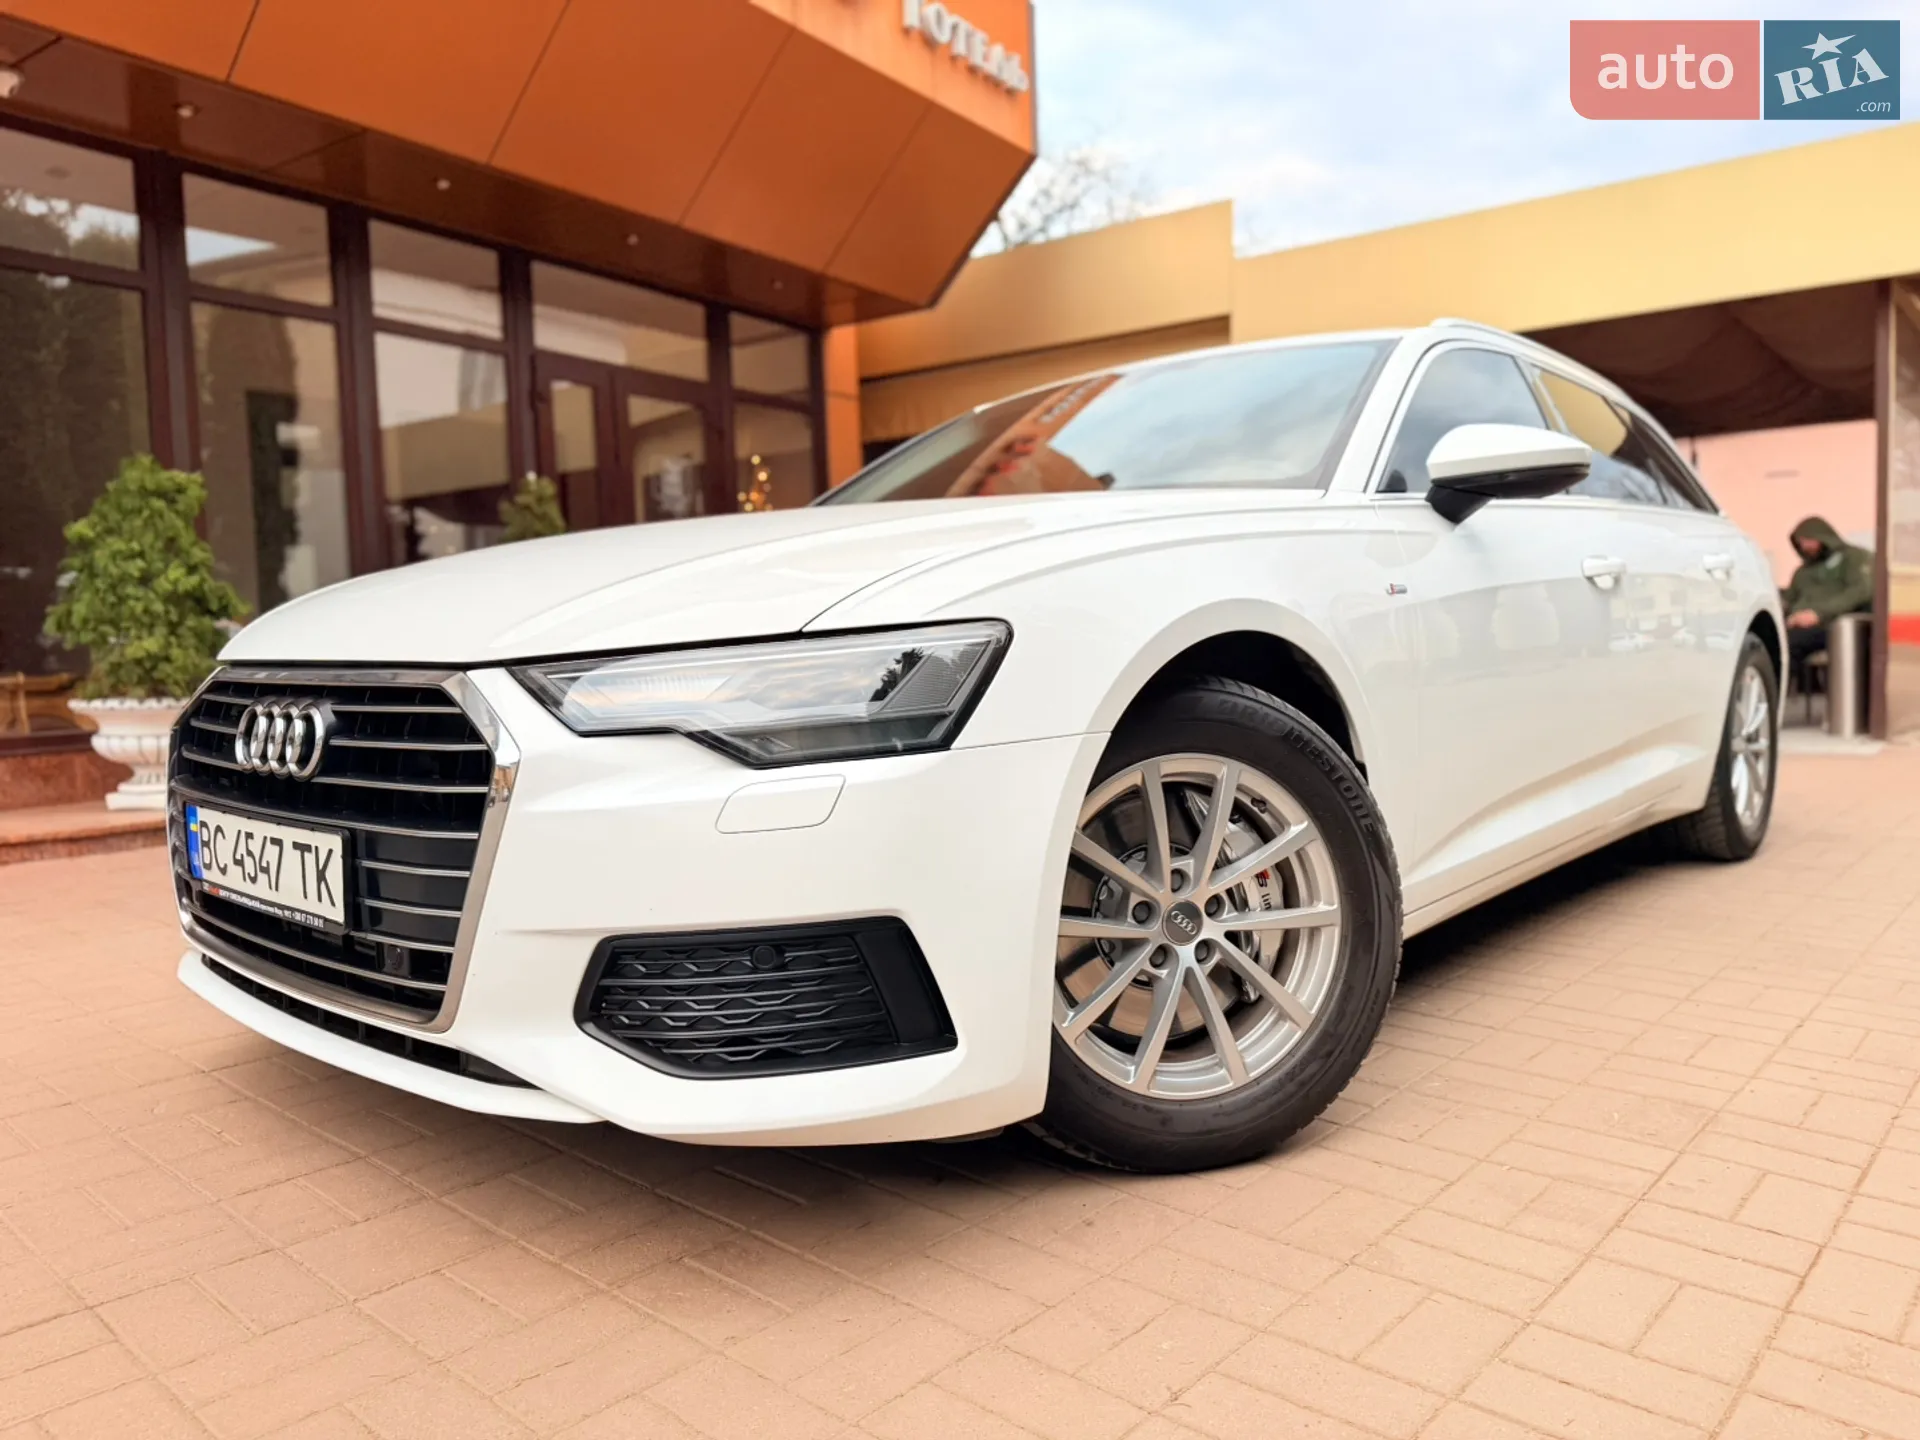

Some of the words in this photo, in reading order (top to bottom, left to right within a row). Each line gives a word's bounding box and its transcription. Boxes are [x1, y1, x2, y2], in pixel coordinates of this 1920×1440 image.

[199, 820, 228, 876] BC
[232, 829, 284, 892] 4547
[292, 841, 336, 907] TK
[1261, 893, 1272, 911] lin
